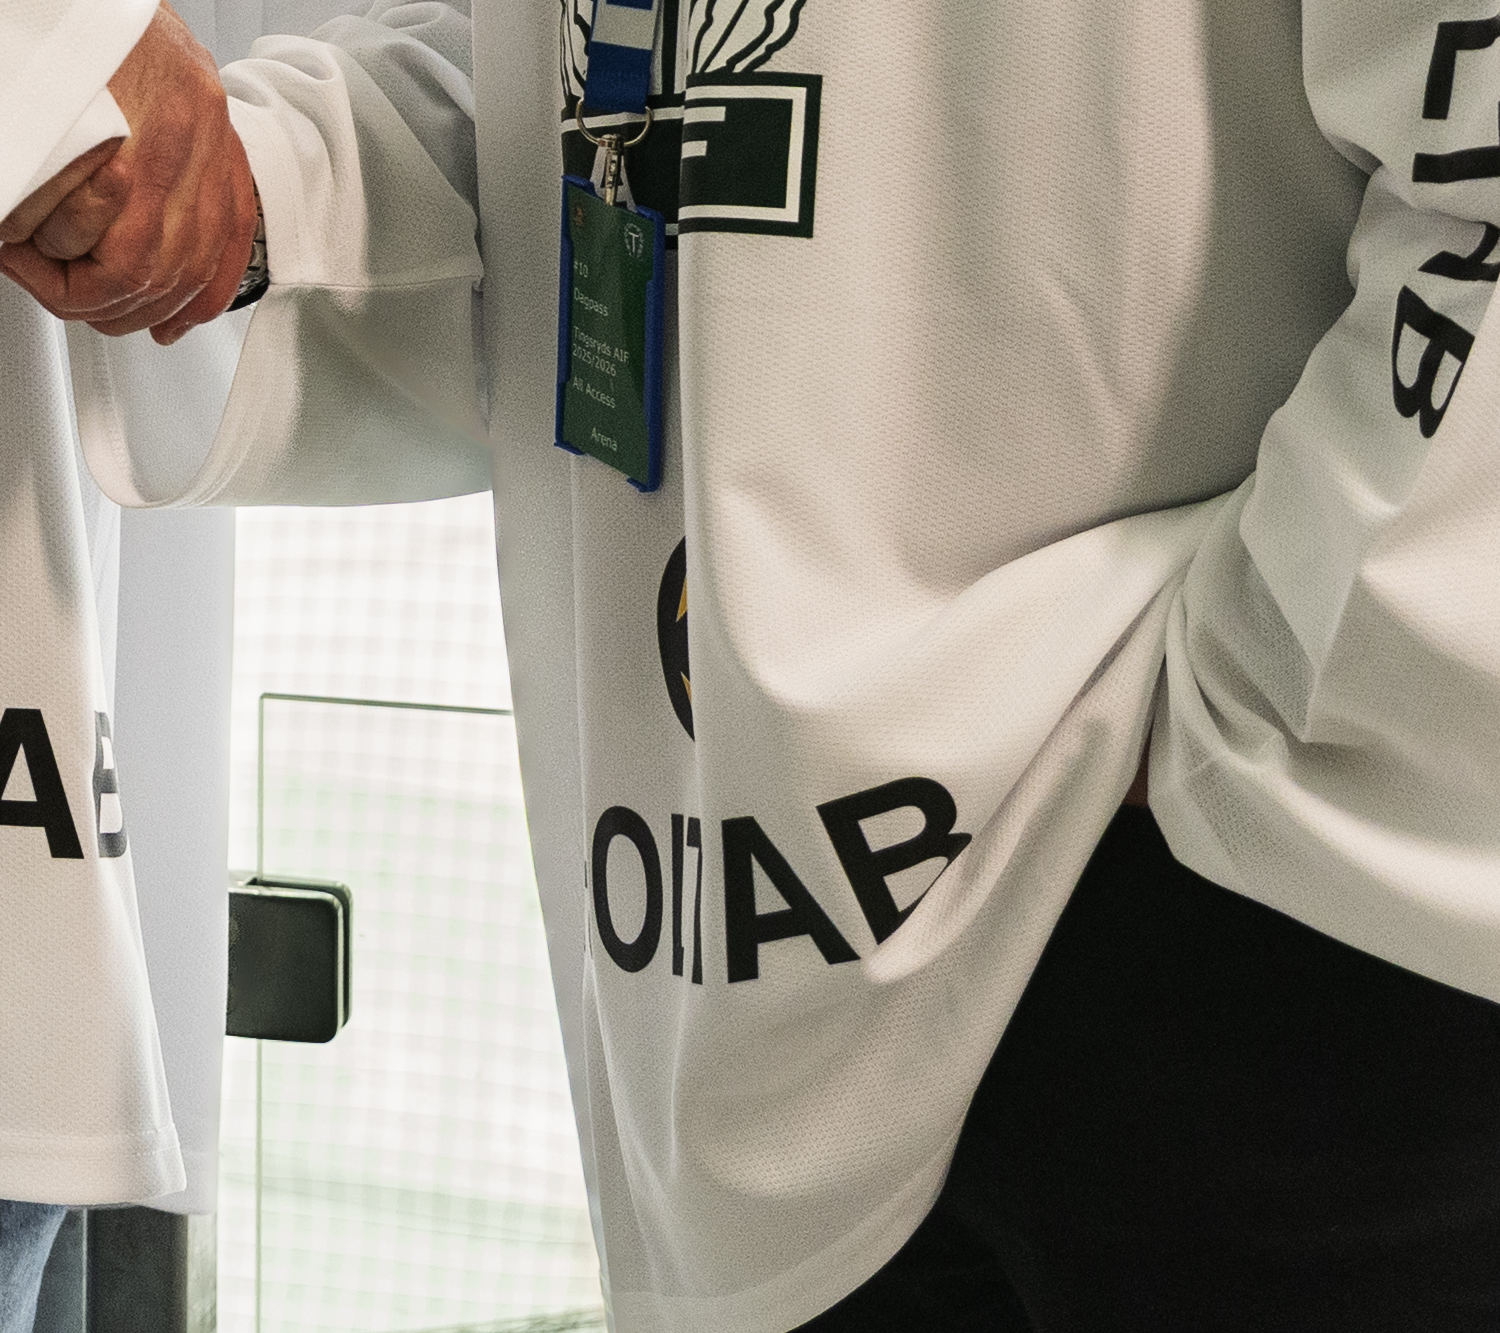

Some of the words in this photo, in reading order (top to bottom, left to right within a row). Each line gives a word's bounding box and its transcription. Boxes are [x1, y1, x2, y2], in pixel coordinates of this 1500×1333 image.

[573, 260, 589, 278] #10
[573, 286, 609, 317] Dagpass
[572, 343, 617, 378] 2025/2026
[573, 326, 612, 358] Tingsryds
[613, 346, 630, 364] AIF
[573, 375, 584, 393] All
[585, 382, 616, 409] Access
[590, 427, 618, 452] Arena
